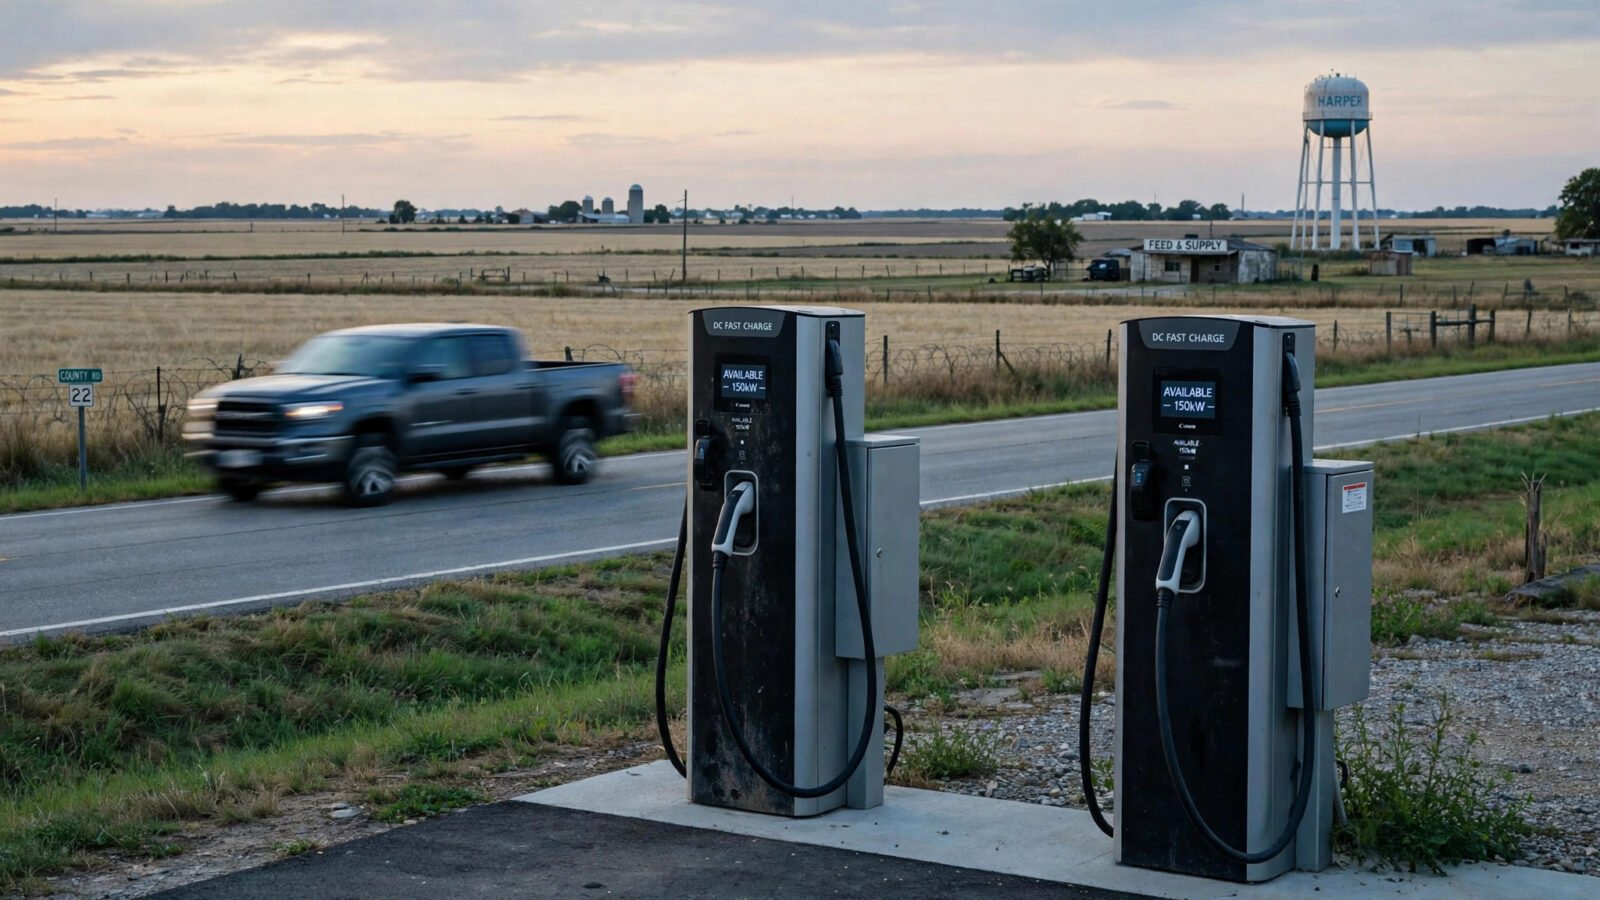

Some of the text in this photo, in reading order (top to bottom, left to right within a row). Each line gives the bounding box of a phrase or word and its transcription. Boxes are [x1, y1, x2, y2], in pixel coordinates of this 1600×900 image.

[1318, 96, 1362, 107] HARPER
[1149, 240, 1222, 250] FEED & SUPPLY
[713, 321, 773, 331] DC FAST CHARGE
[1152, 333, 1225, 343] DC FAST CHARGE
[60, 371, 88, 380] COUNTY
[723, 369, 764, 380] AVAILABLE
[732, 382, 758, 392] 150kW
[1163, 386, 1213, 398] AVAILABLE
[72, 388, 91, 402] 22
[1174, 400, 1206, 412] 150kW
